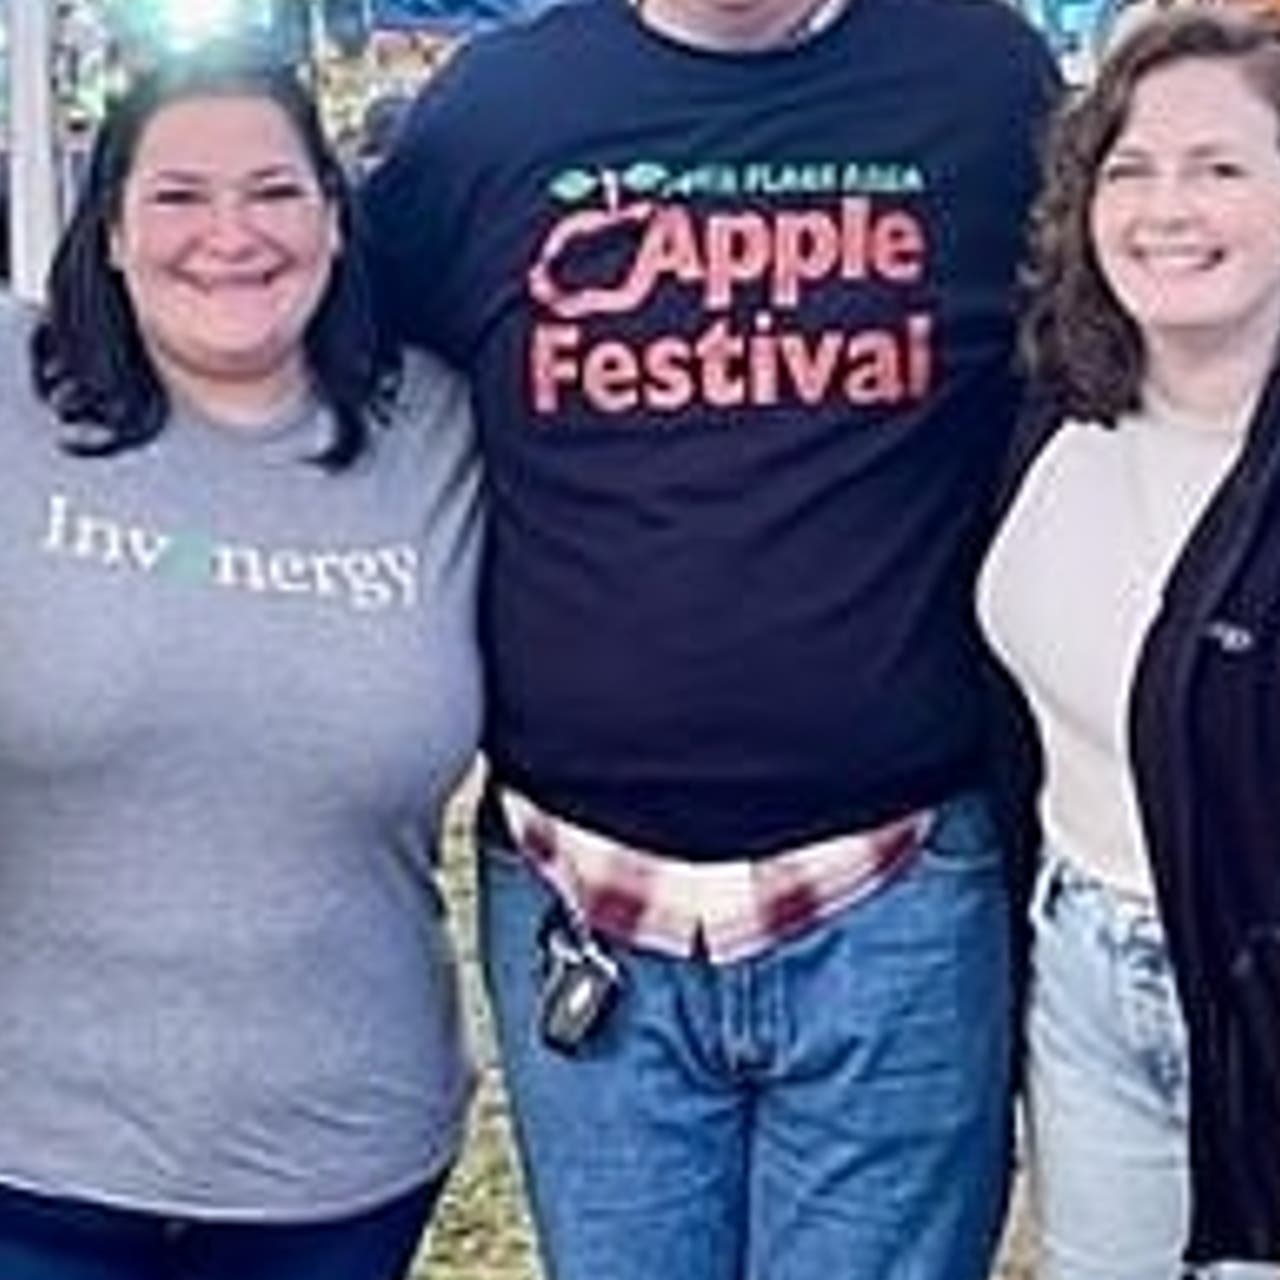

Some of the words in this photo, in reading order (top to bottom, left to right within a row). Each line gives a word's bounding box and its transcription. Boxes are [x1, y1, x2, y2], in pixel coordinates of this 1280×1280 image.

[635, 196, 926, 310] Apple
[529, 311, 932, 414] Festival
[41, 492, 420, 611] Invnergy
